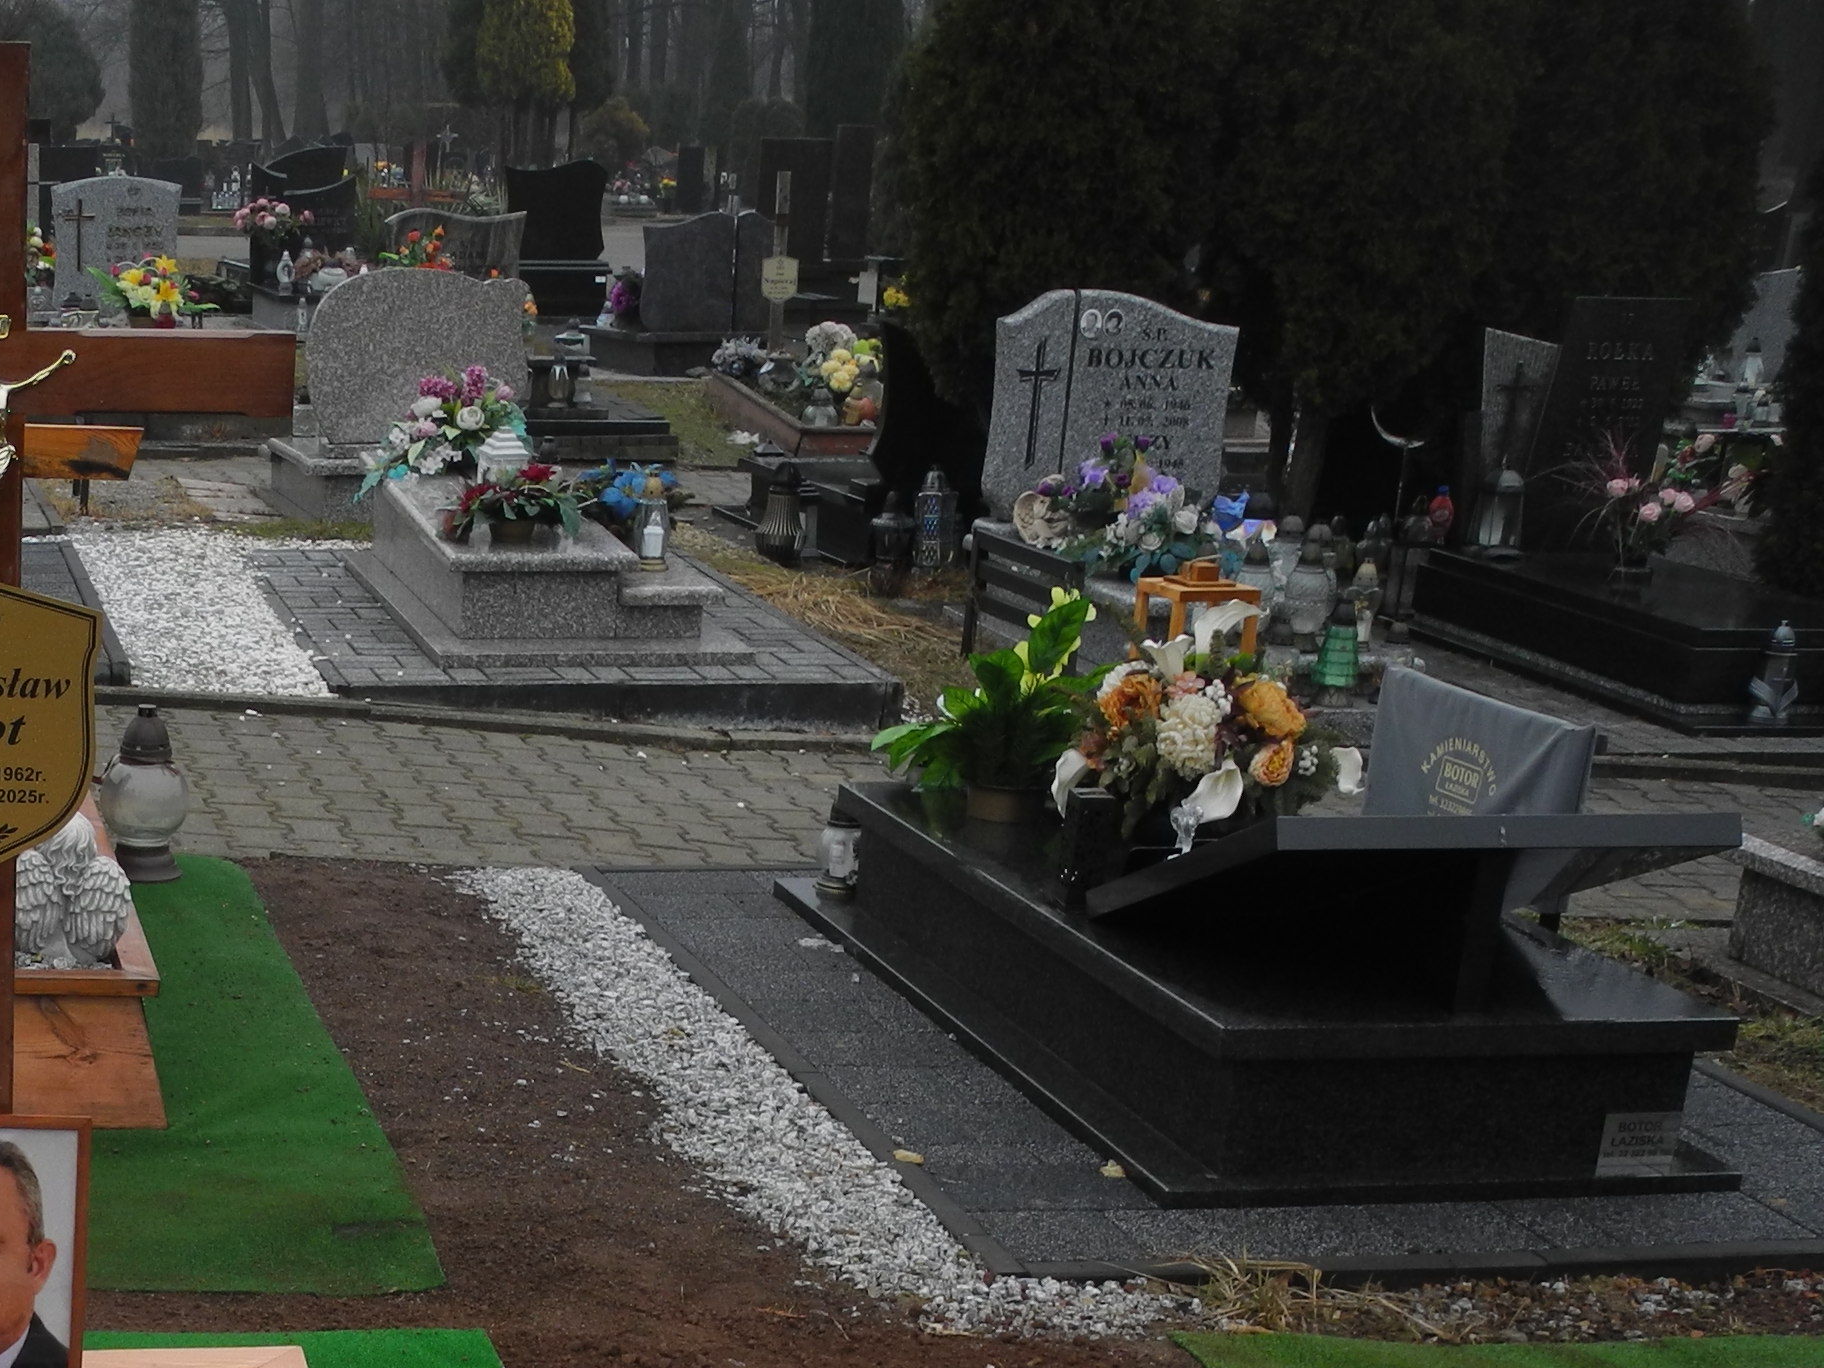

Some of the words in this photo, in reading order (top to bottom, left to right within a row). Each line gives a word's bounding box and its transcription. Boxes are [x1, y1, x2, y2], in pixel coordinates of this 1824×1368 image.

[1087, 347, 1215, 370] BOJCZUK
[1119, 375, 1178, 391] ANNA
[1420, 737, 1497, 797] KAMIENIARSTWO
[1443, 761, 1480, 789] BOTOR
[1618, 1121, 1663, 1133] BOTOR
